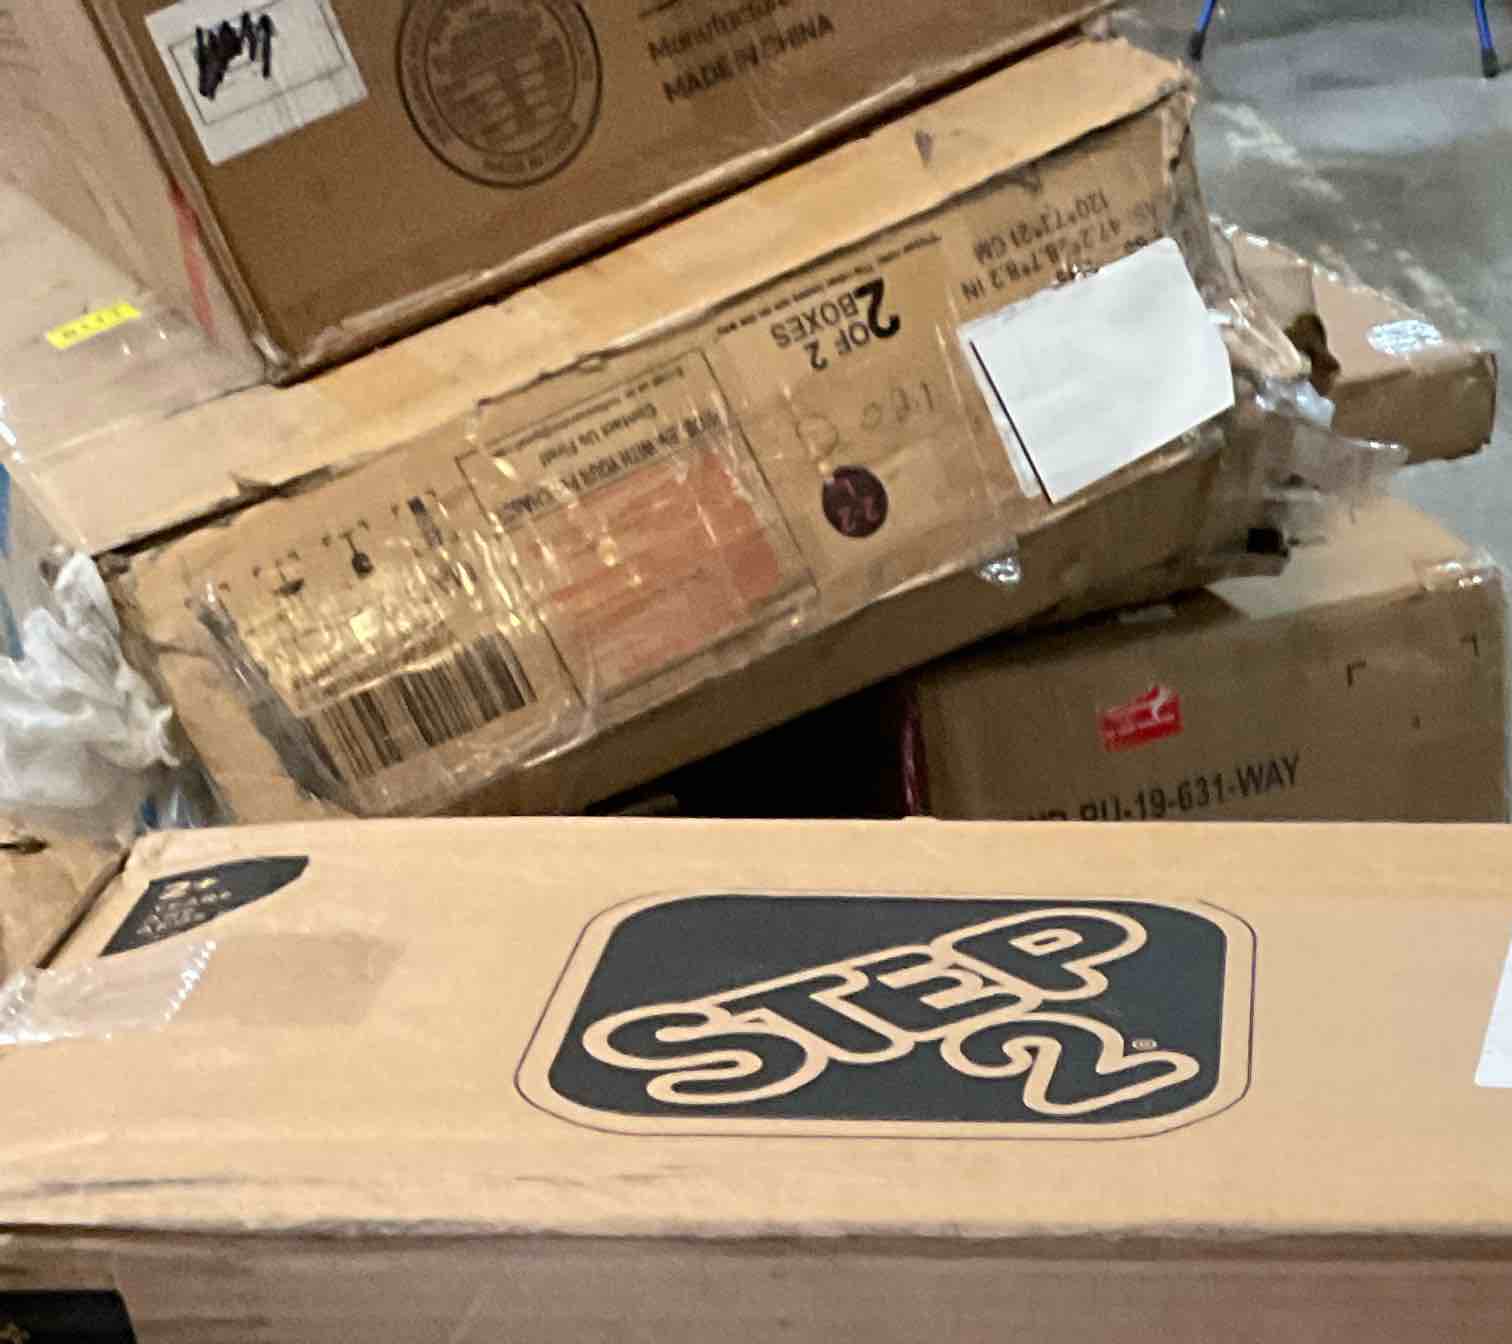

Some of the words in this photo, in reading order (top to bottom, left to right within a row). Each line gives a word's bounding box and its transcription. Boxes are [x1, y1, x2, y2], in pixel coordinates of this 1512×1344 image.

[662, 55, 734, 103] MADE
[733, 44, 759, 73] IN
[760, 13, 834, 62] CHINA
[769, 292, 859, 349] BOXES
[834, 320, 872, 355] OF
[852, 277, 901, 339] 2
[803, 340, 828, 371] 2
[583, 905, 1149, 1104] STEP
[940, 1011, 1200, 1118] 2
